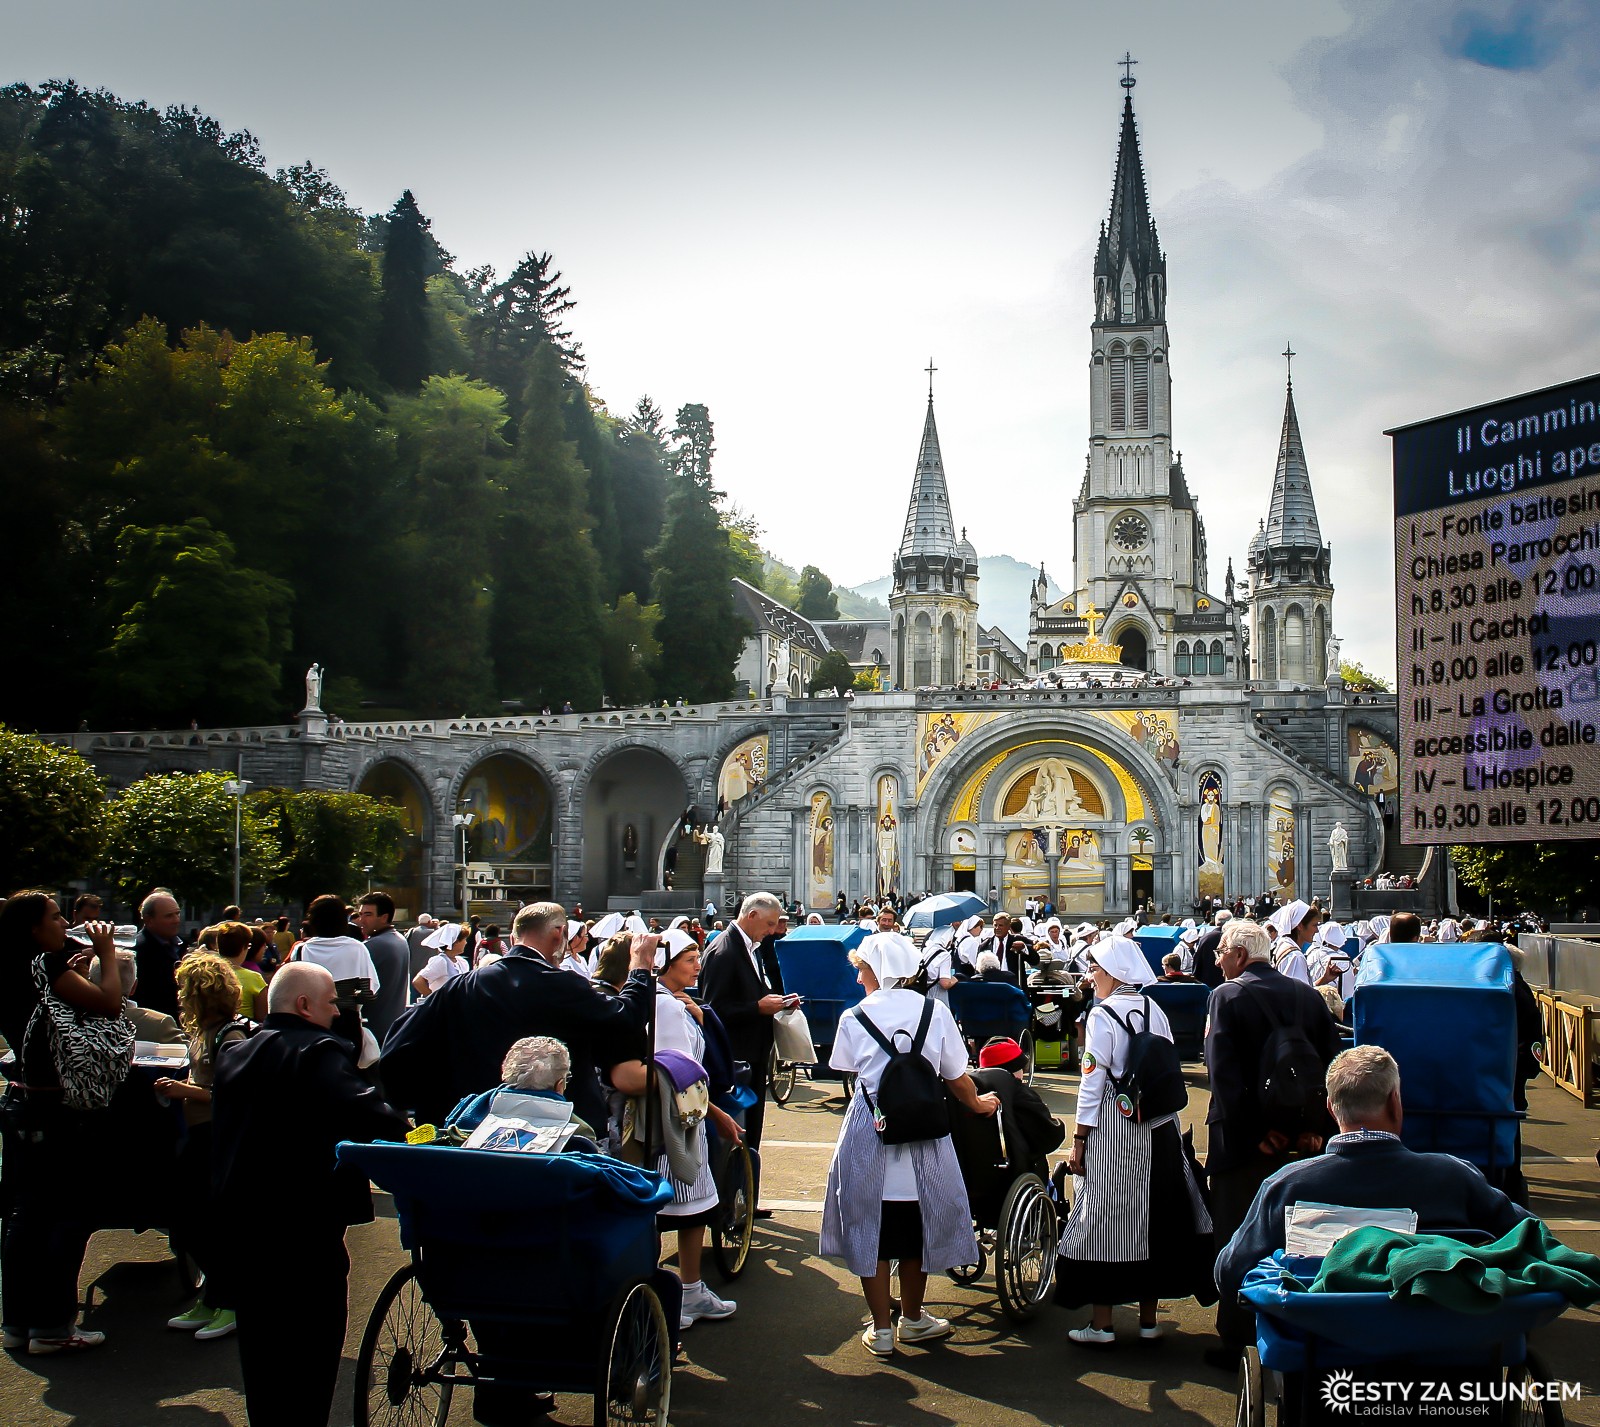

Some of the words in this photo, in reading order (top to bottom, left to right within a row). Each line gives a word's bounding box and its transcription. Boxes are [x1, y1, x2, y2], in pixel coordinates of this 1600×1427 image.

[1480, 399, 1600, 447] Cammin
[1448, 449, 1542, 497] Luoghi
[1411, 520, 1415, 545] I
[1442, 510, 1503, 540] Fonte
[1411, 551, 1483, 580] Chiesa
[1484, 578, 1522, 603] alle
[1470, 612, 1549, 643] Cachot
[1485, 651, 1523, 678] alle
[1413, 697, 1431, 722] III
[1459, 694, 1485, 717] La
[1493, 686, 1562, 713] Grotta
[1413, 726, 1533, 757] accessibile
[1540, 720, 1596, 747] dalle
[1414, 769, 1436, 793] IV
[1463, 761, 1573, 793] L'Hospice
[1488, 802, 1526, 826] alle
